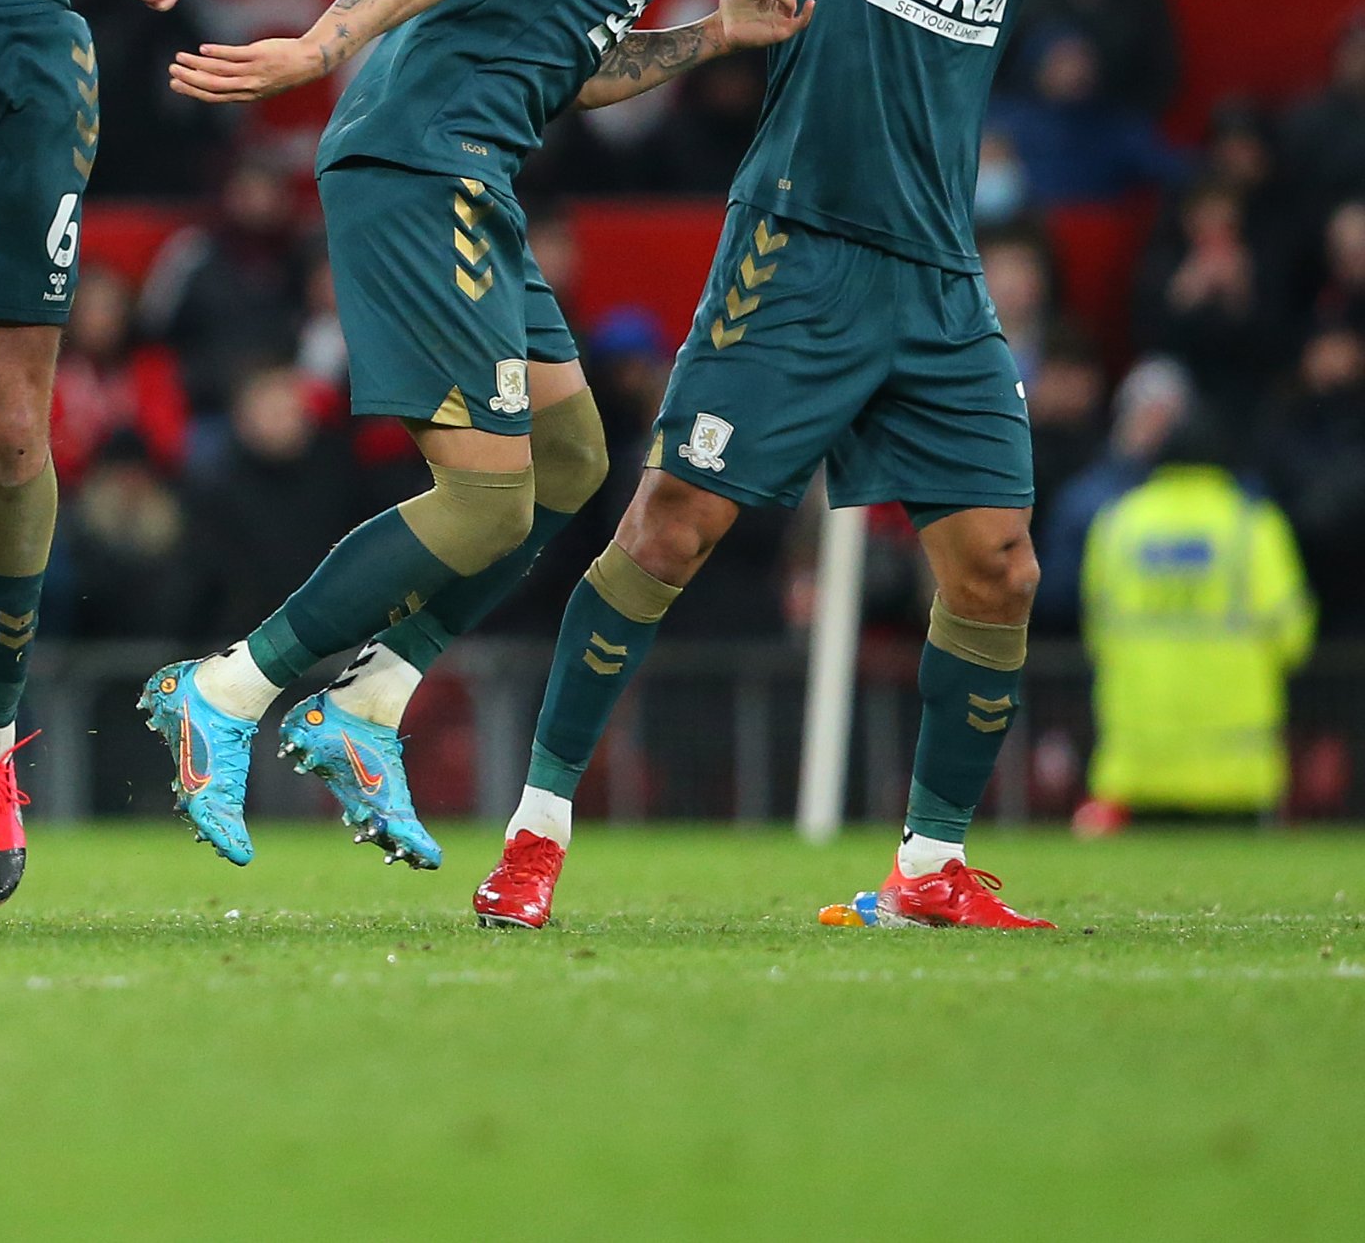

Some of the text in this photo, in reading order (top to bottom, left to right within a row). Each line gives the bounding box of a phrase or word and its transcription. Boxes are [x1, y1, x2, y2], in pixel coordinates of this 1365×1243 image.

[895, 0, 920, 18] SET
[922, 13, 955, 35] YOUR
[46, 193, 78, 267] 6
